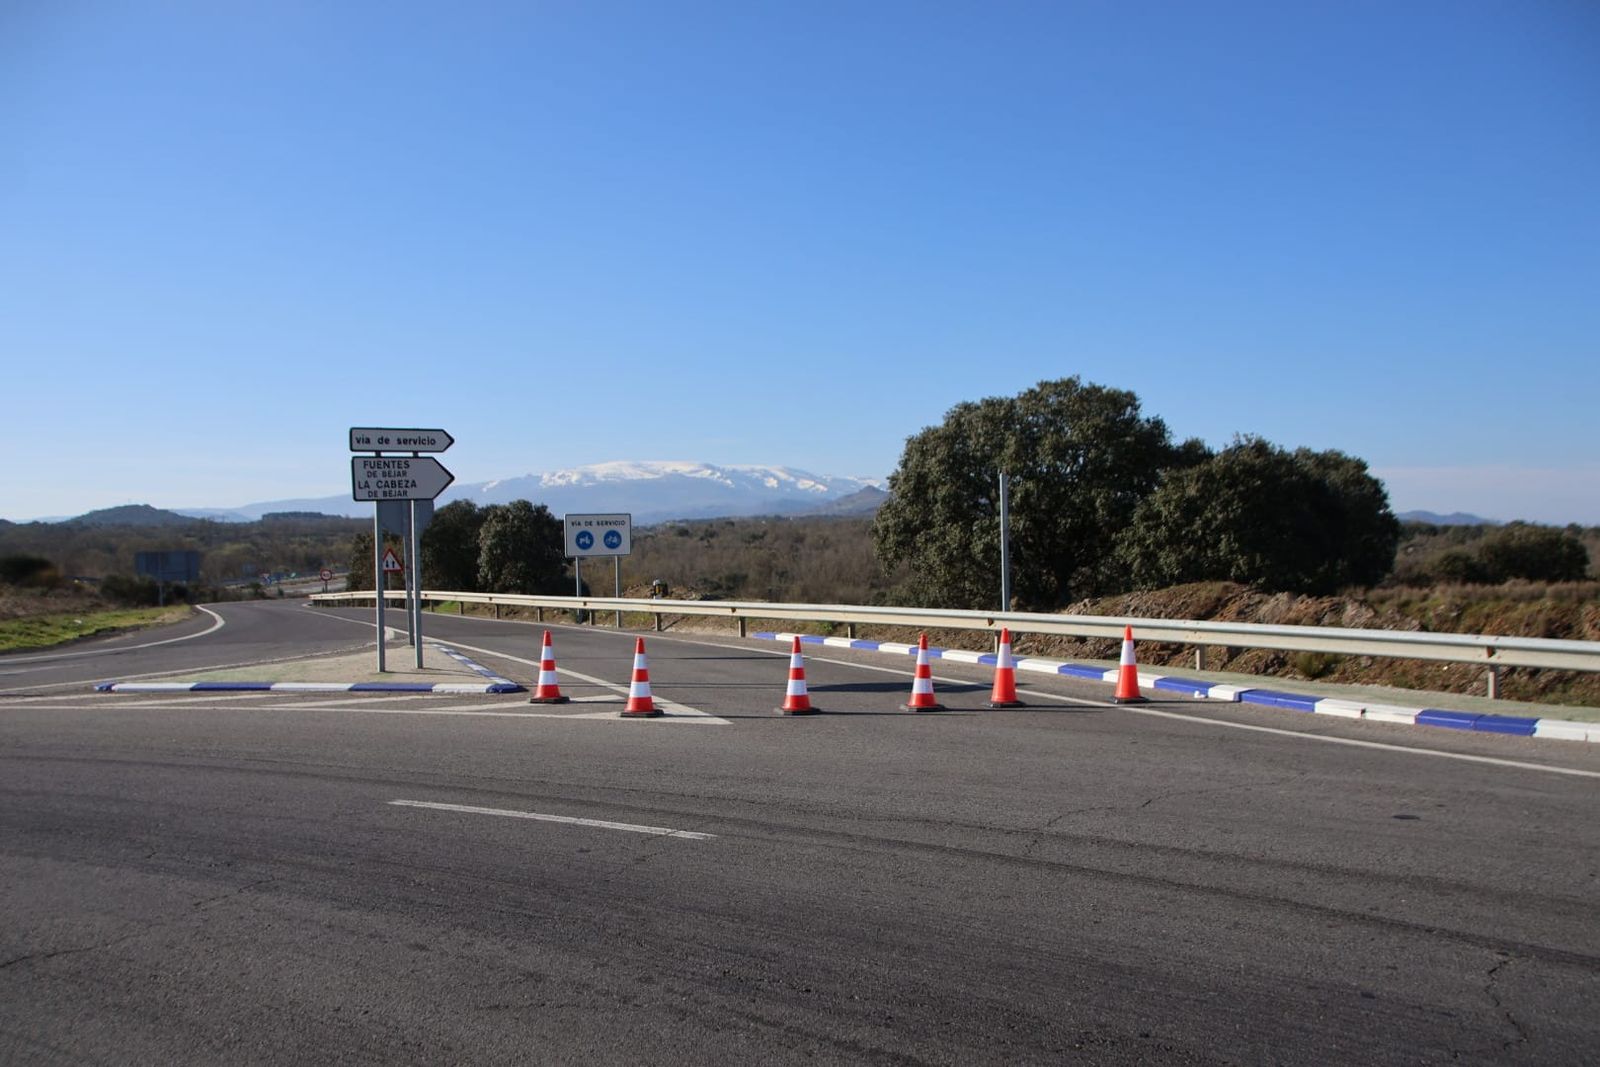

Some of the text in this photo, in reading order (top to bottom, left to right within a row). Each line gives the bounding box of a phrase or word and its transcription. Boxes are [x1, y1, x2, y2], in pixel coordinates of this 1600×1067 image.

[377, 435, 391, 445] de
[396, 435, 436, 446] servicio
[363, 460, 410, 469] FUENTES
[367, 470, 378, 478] DE
[358, 479, 417, 489] LA CABEZA
[368, 490, 378, 498] DE
